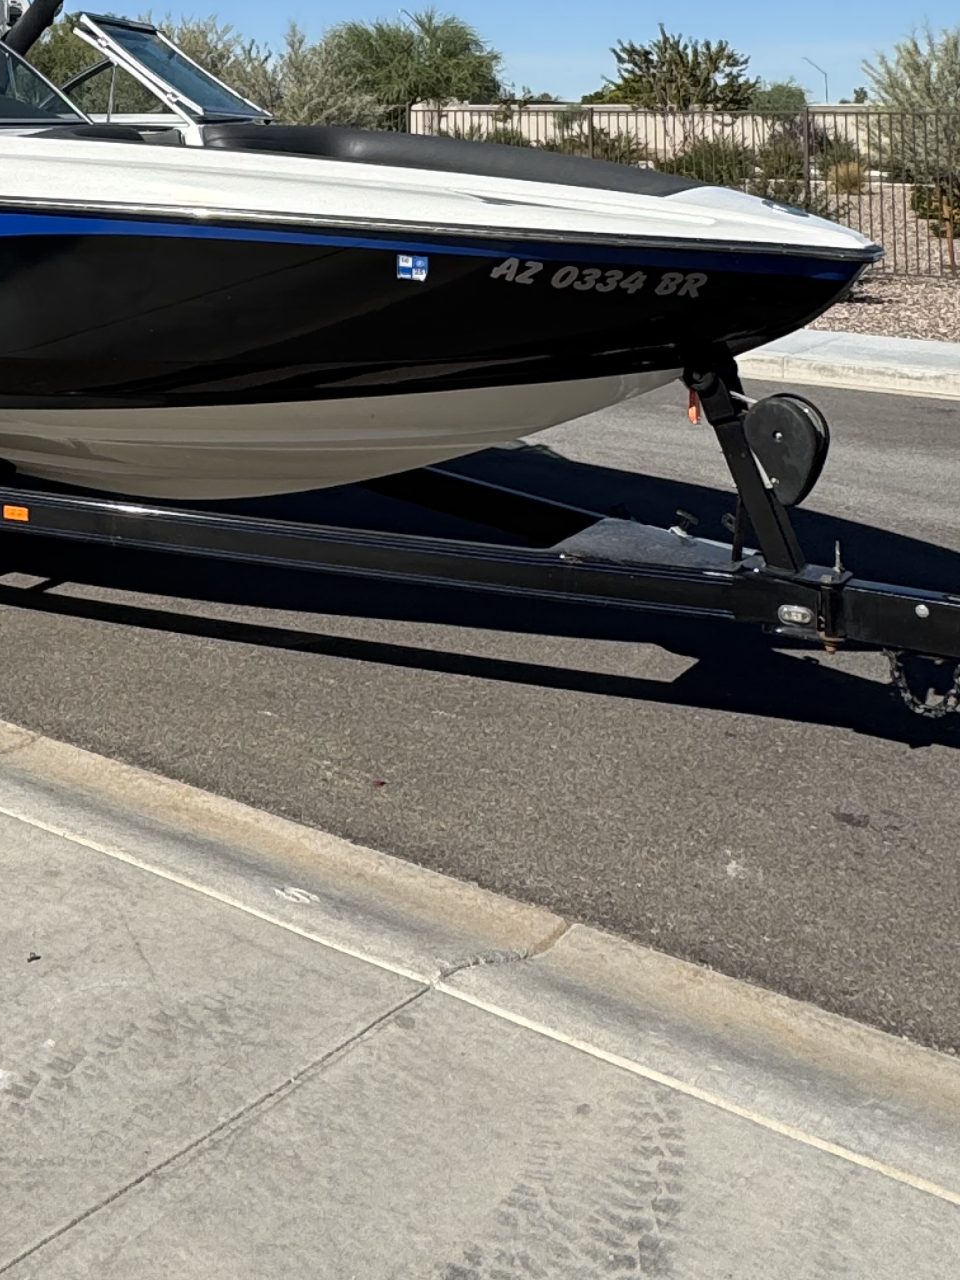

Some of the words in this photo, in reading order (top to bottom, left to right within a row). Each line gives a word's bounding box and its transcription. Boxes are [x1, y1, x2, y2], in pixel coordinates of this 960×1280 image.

[490, 256, 543, 285] AZ
[550, 265, 648, 294] 0334
[654, 272, 708, 298] BR
